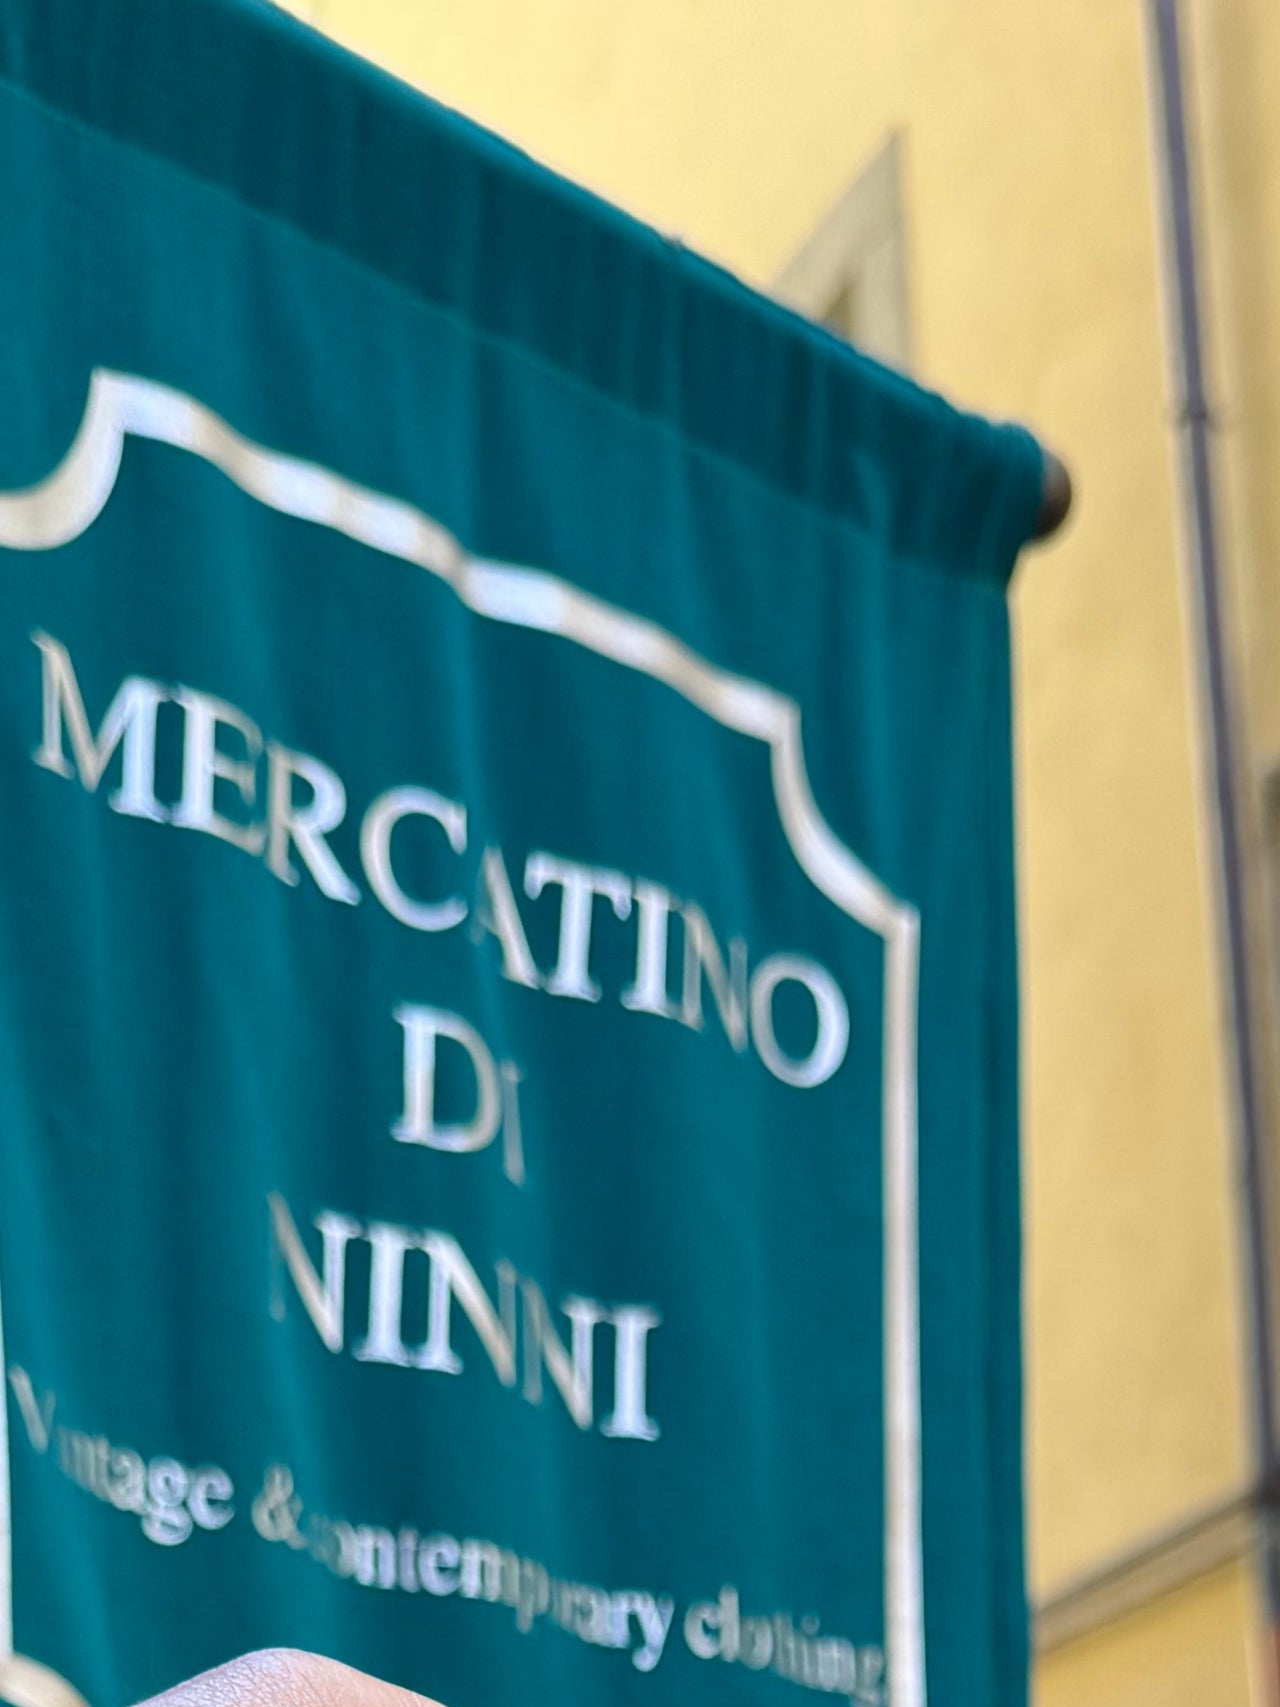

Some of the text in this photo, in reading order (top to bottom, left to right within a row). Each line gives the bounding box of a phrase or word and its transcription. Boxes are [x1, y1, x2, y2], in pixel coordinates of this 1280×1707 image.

[29, 627, 850, 1089] MERCATINO
[266, 1189, 662, 1443] NINNI
[8, 1362, 235, 1548] Vntage
[251, 1462, 306, 1551] &
